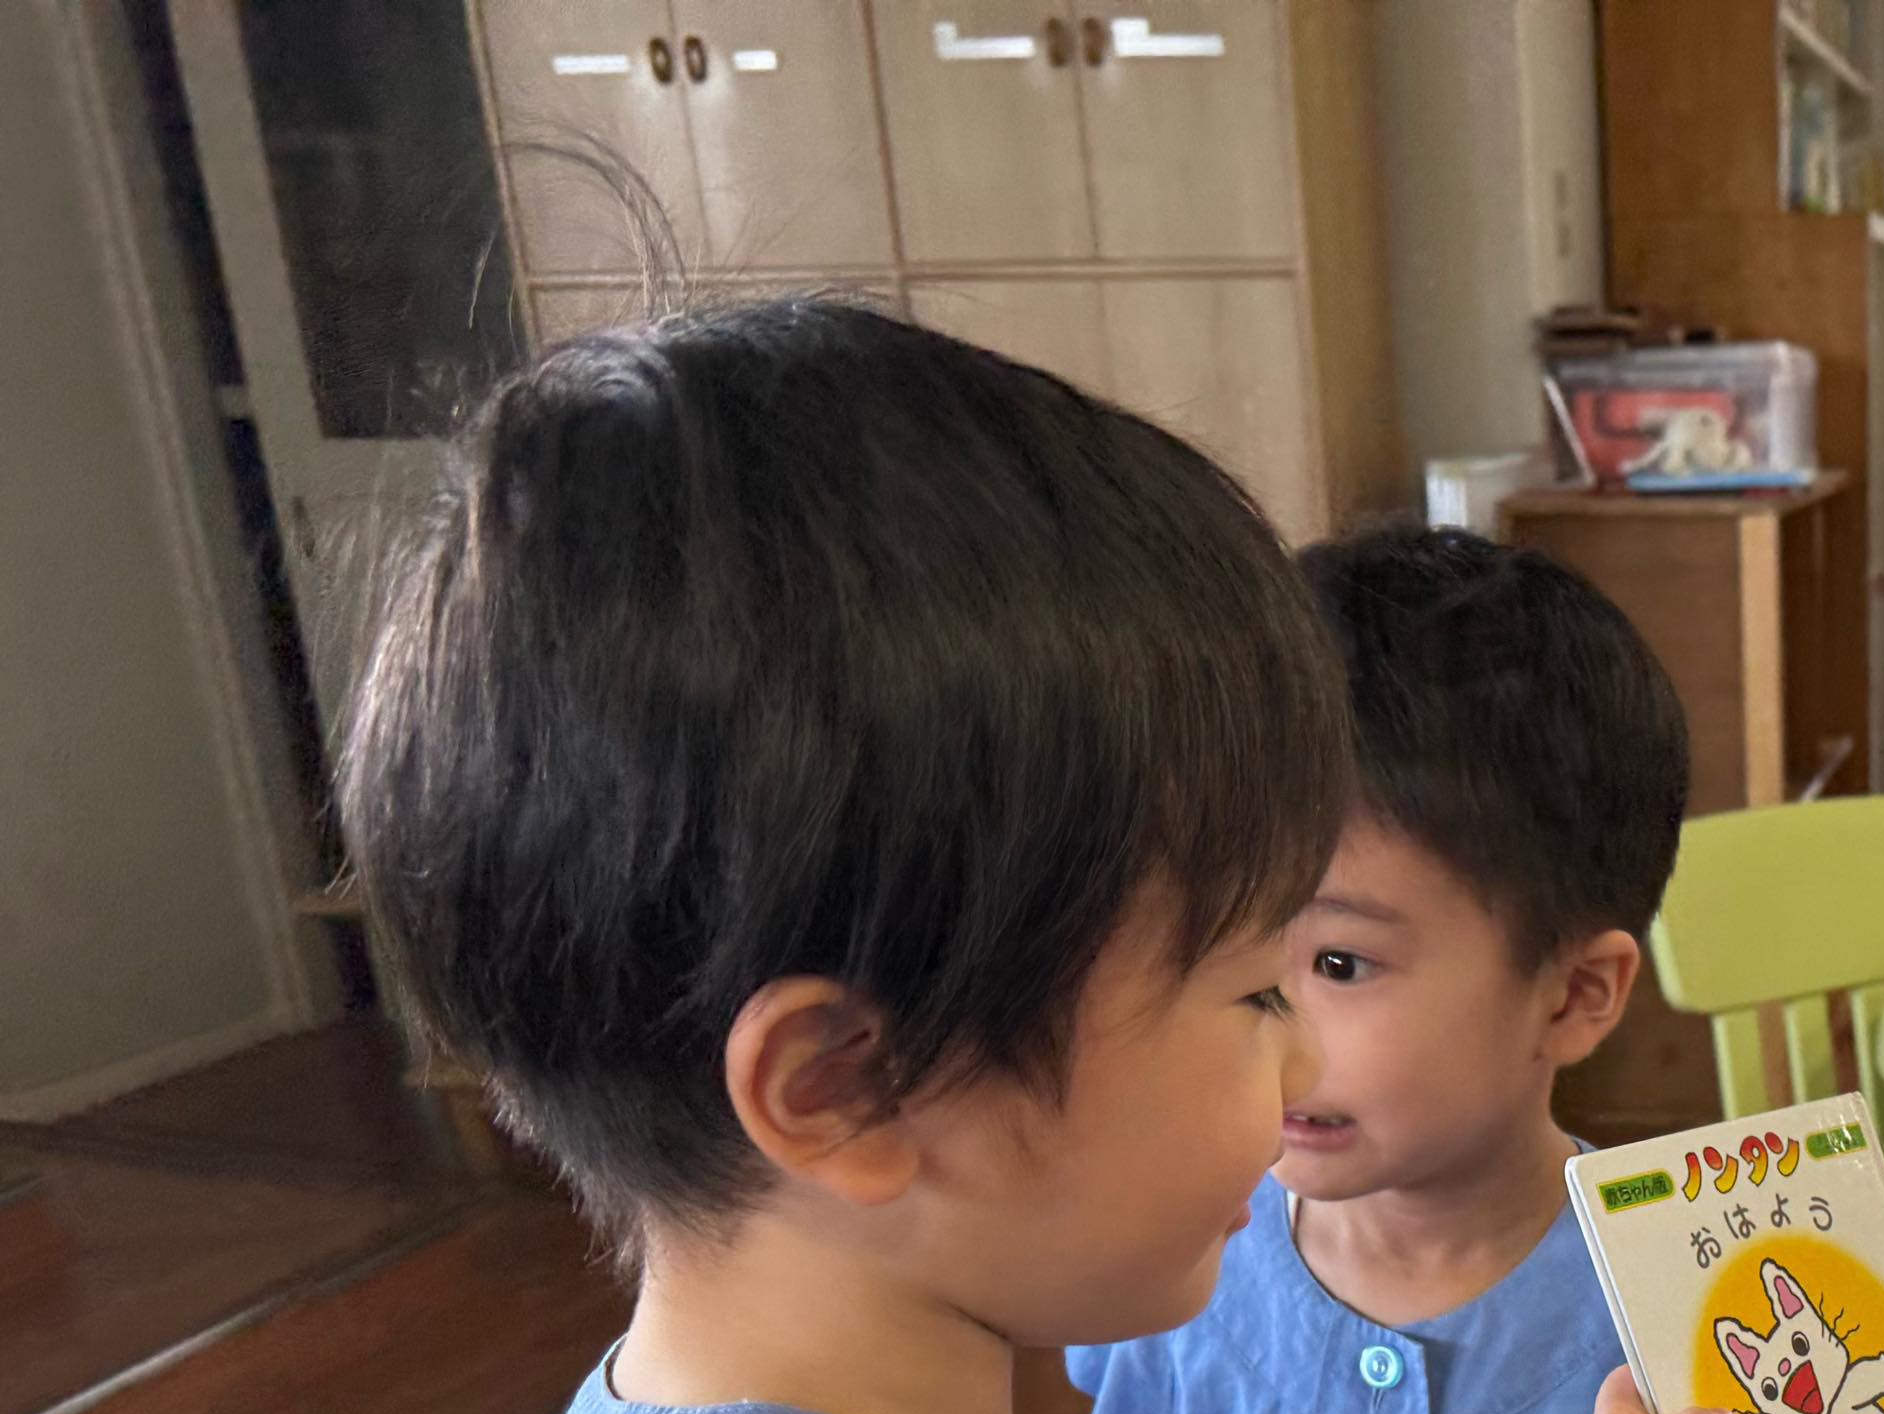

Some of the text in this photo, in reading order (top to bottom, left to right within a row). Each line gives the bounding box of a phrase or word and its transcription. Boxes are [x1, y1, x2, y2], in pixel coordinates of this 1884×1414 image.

[1682, 1132, 1799, 1202] ノンタン
[1691, 1193, 1833, 1268] おはよう
